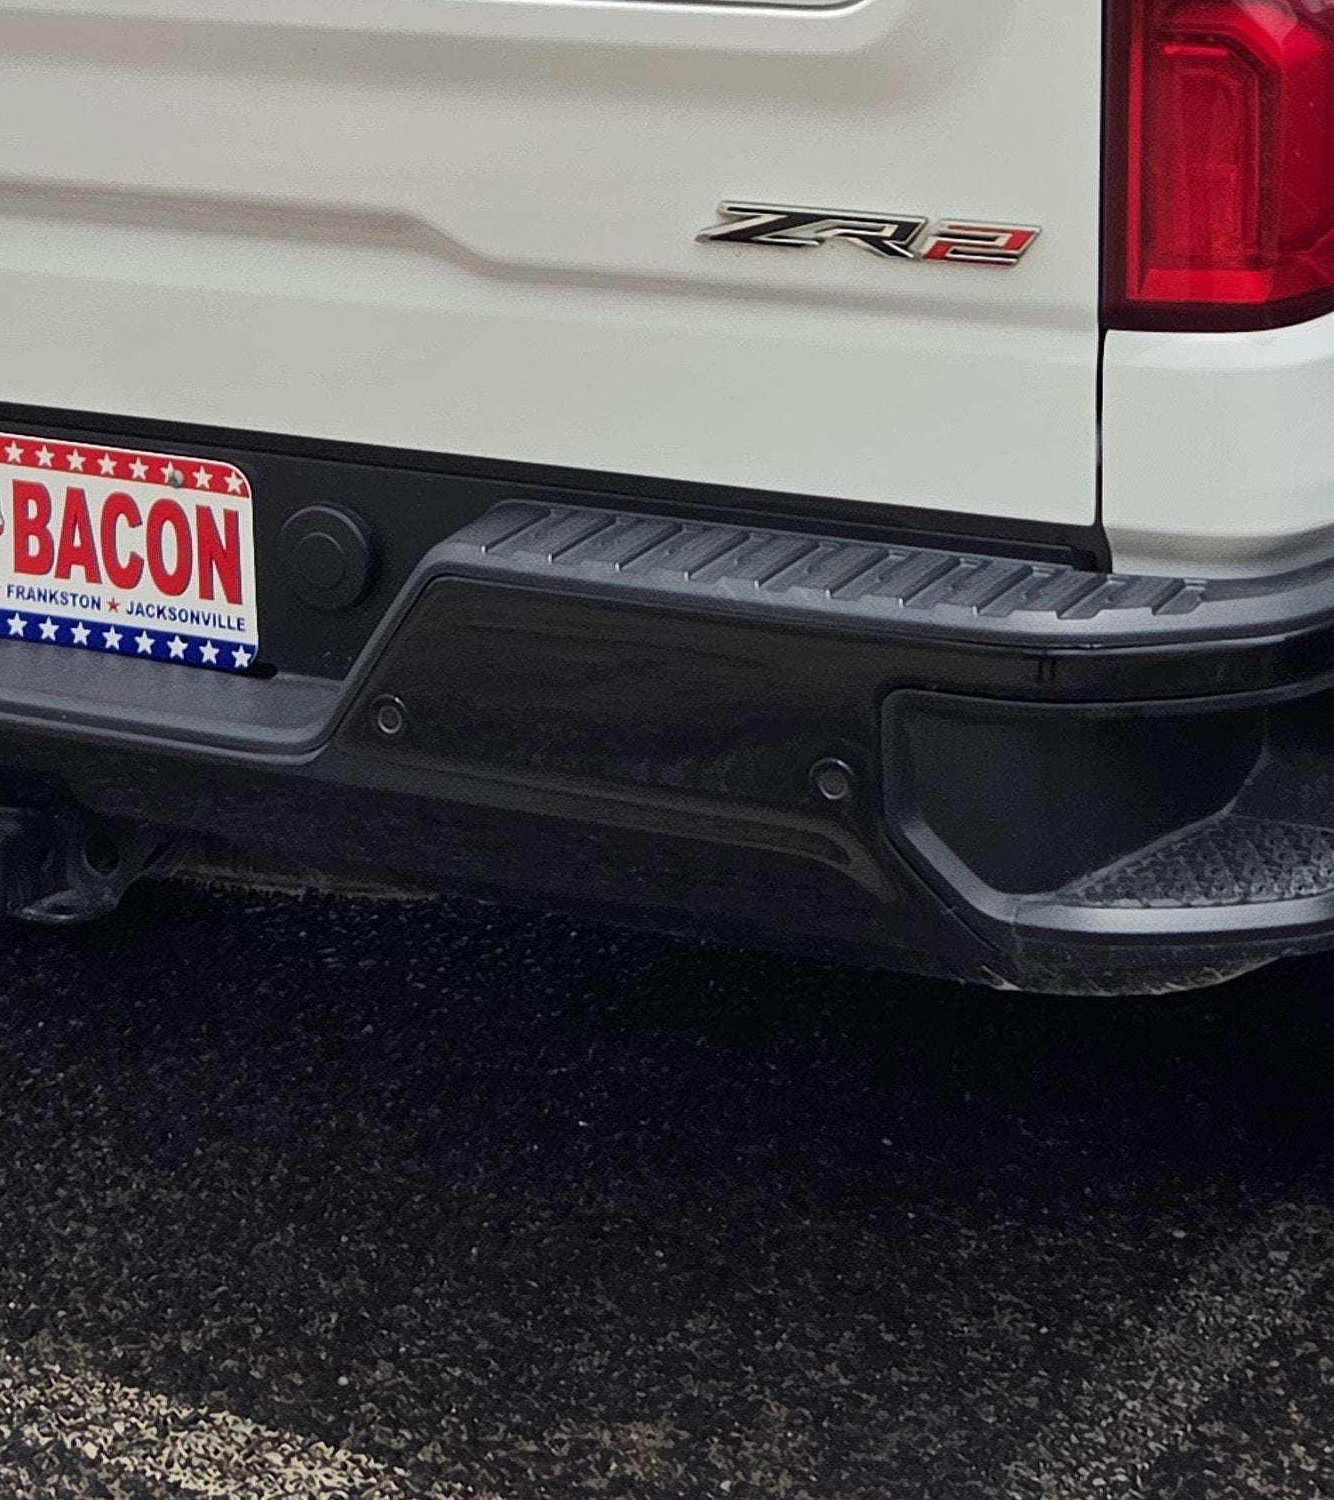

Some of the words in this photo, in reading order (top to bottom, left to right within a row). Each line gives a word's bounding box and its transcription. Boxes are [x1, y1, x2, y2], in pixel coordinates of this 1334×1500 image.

[694, 200, 1042, 267] ZR2
[12, 478, 243, 606] BACON
[7, 584, 102, 612] FRANKSTON
[125, 601, 246, 632] JACKSONVILLE
